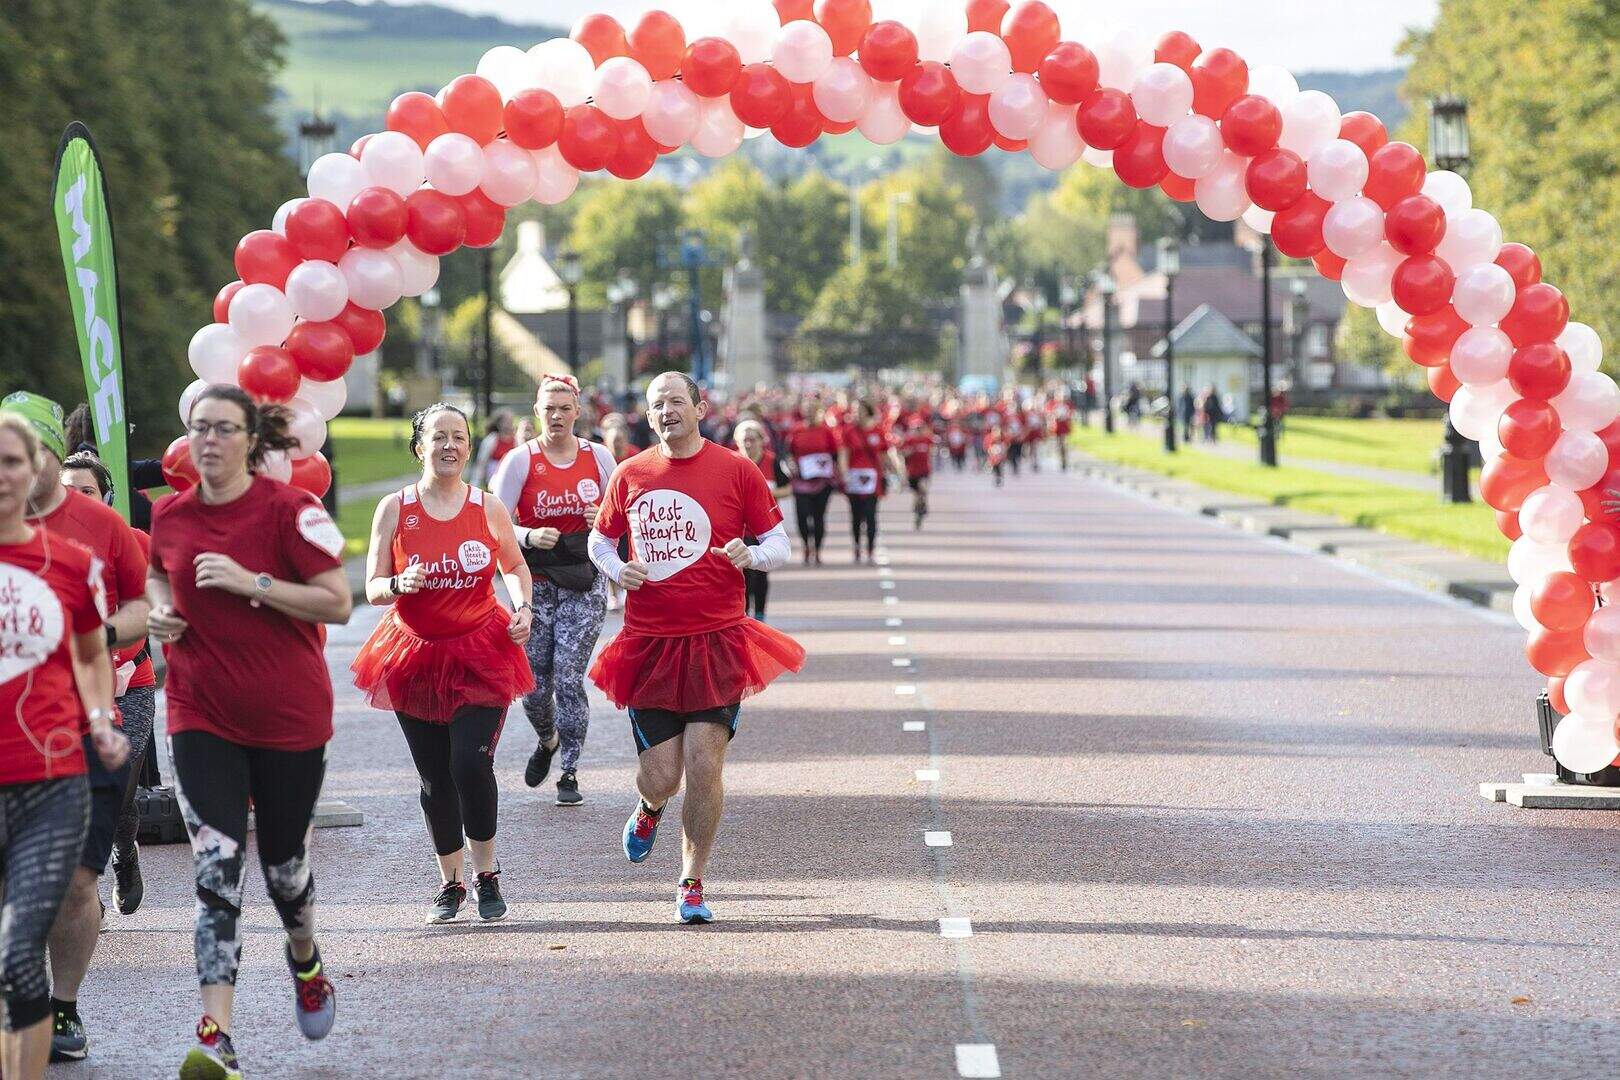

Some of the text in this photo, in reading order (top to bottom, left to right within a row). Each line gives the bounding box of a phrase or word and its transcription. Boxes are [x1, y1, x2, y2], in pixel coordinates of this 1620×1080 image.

[532, 501, 584, 519] Rememb
[638, 499, 682, 523] Chest
[639, 521, 698, 542] Heart &
[644, 542, 693, 563] Stroke
